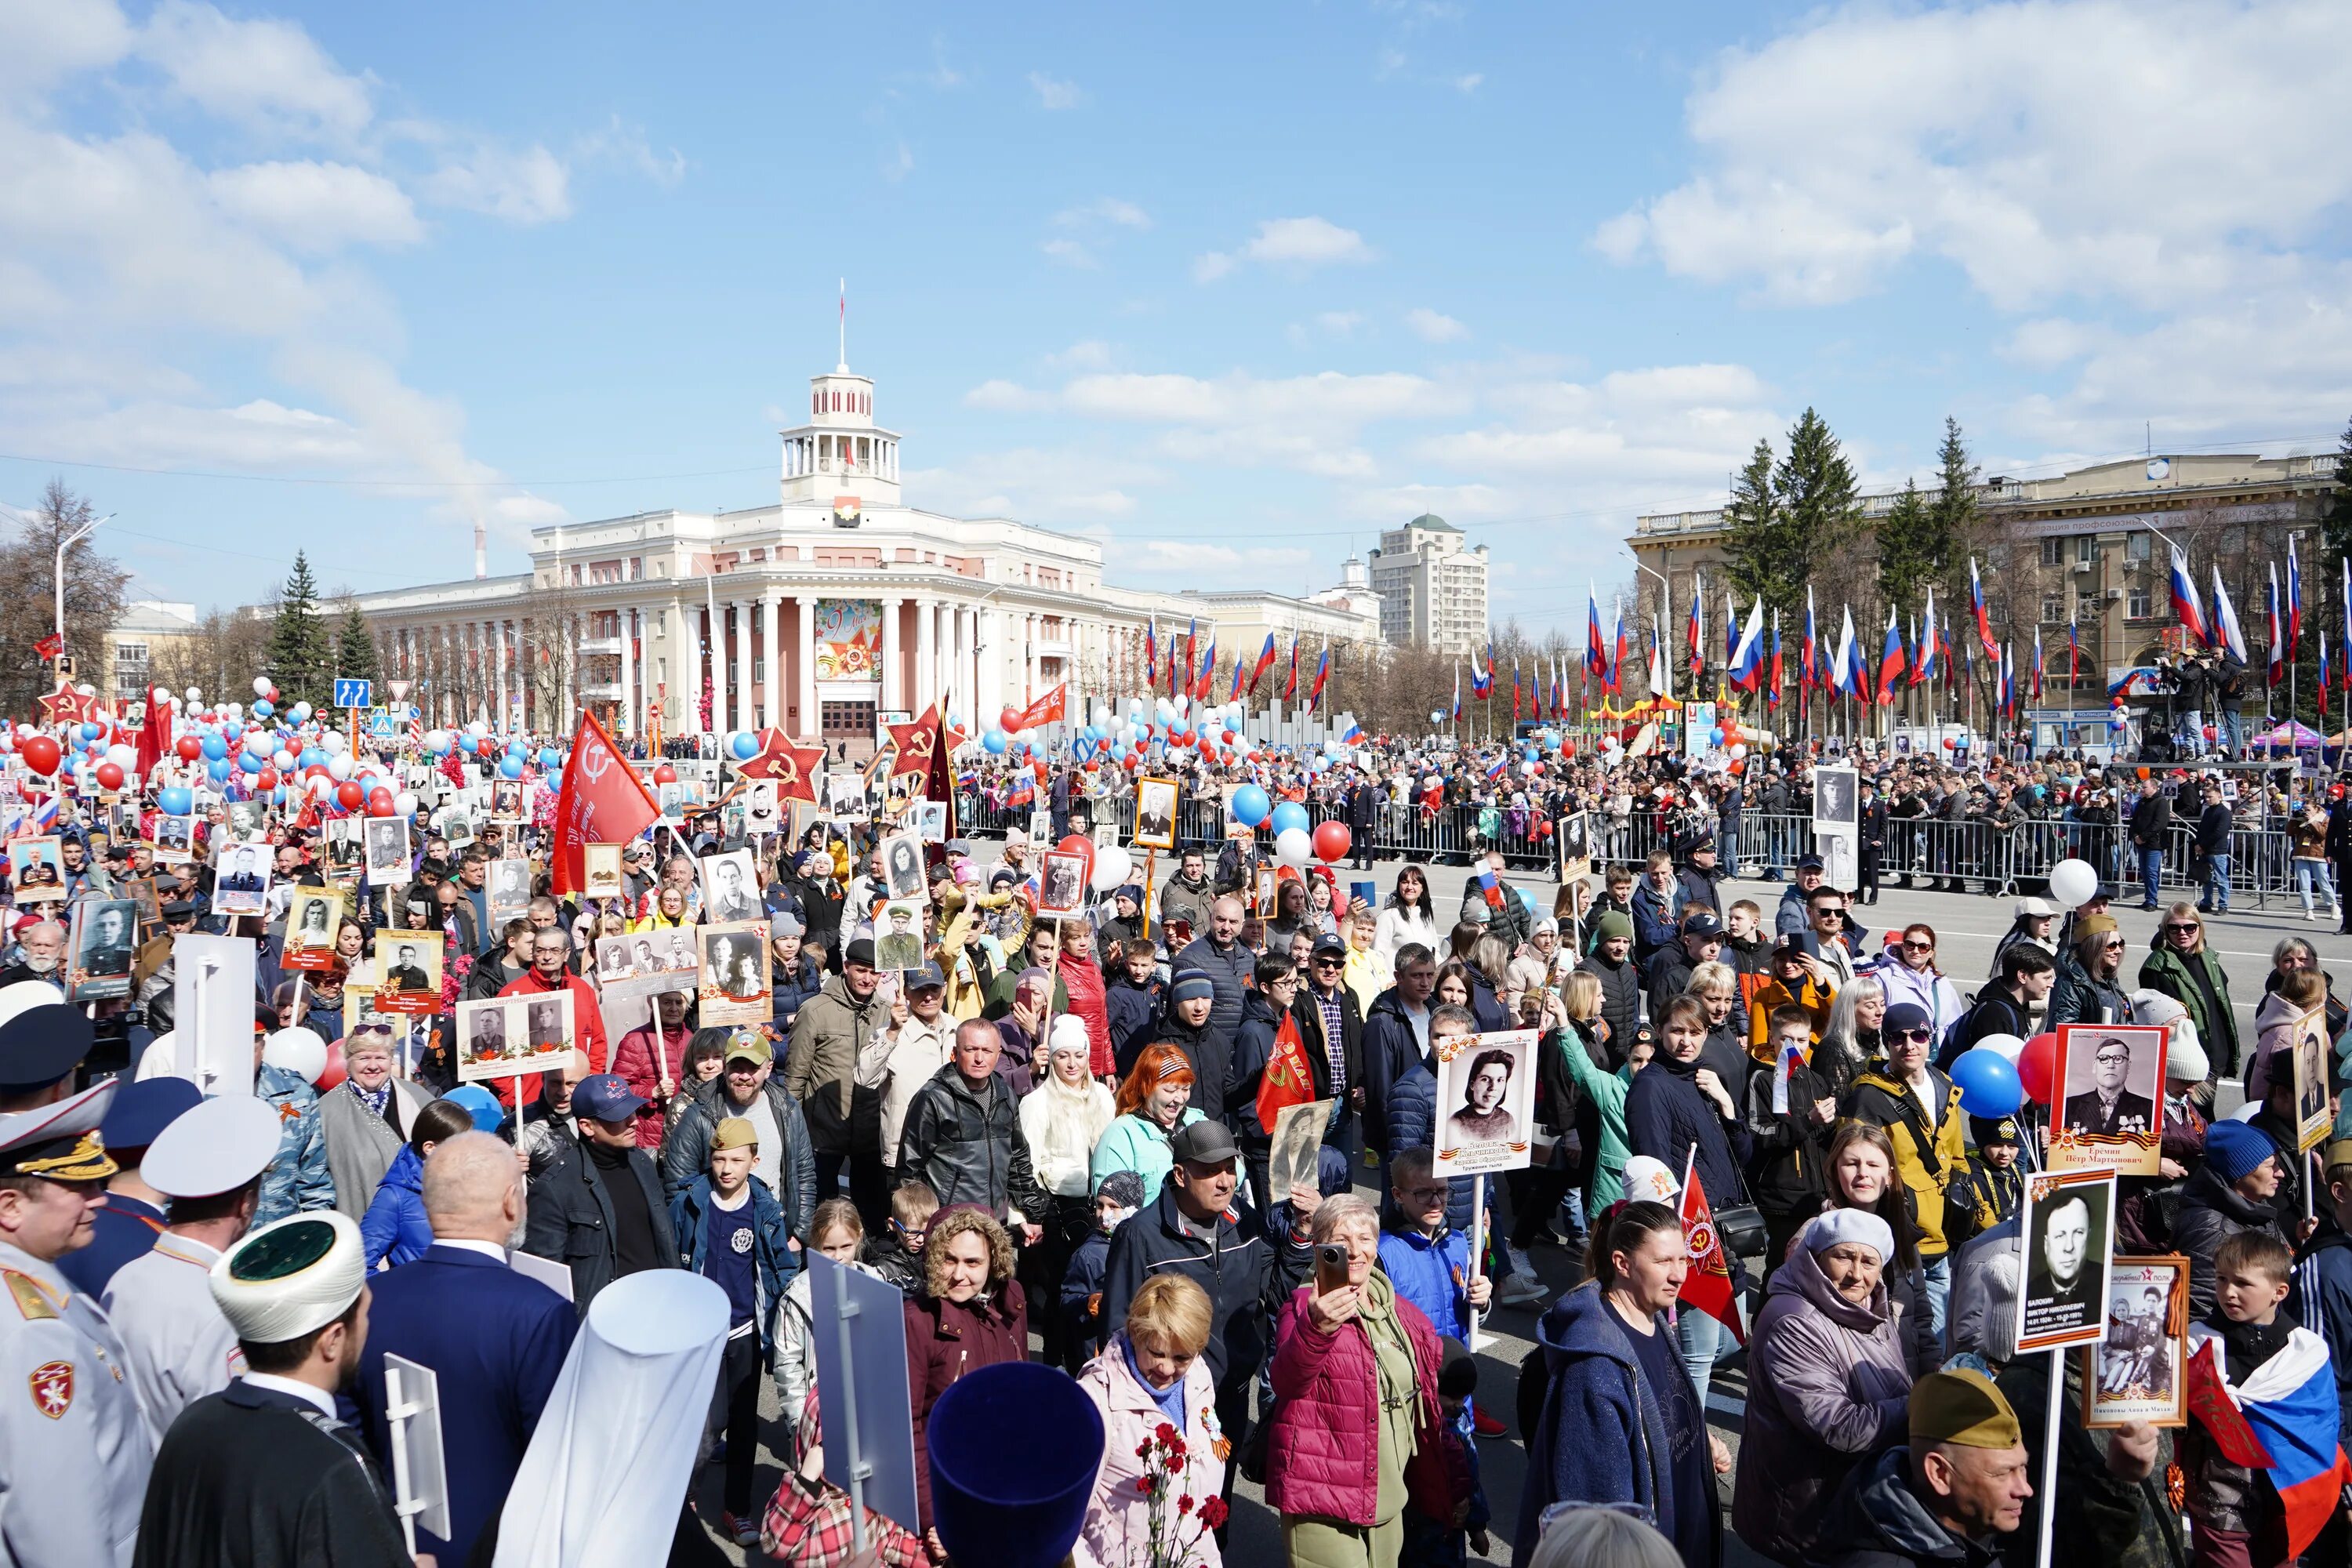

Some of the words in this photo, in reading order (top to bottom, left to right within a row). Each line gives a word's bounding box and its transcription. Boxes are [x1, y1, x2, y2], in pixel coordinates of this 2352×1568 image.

[827, 609, 842, 640] 9
[918, 968, 932, 978] NY
[478, 997, 531, 1007] БЕССМЕРТНЫЙ
[1283, 1041, 1295, 1054] 9
[1288, 1054, 1312, 1091] МАЯ
[2089, 1147, 2120, 1156] Ерёмин
[2066, 1155, 2086, 1163] Пётр
[2089, 1156, 2142, 1164] Мартынович
[2111, 1273, 2141, 1283] смертный
[2027, 1298, 2054, 1308] БАЛОКИН
[2027, 1308, 2049, 1317] ВИКТОР
[2049, 1302, 2085, 1314] НИКОЛАЕВИЧ
